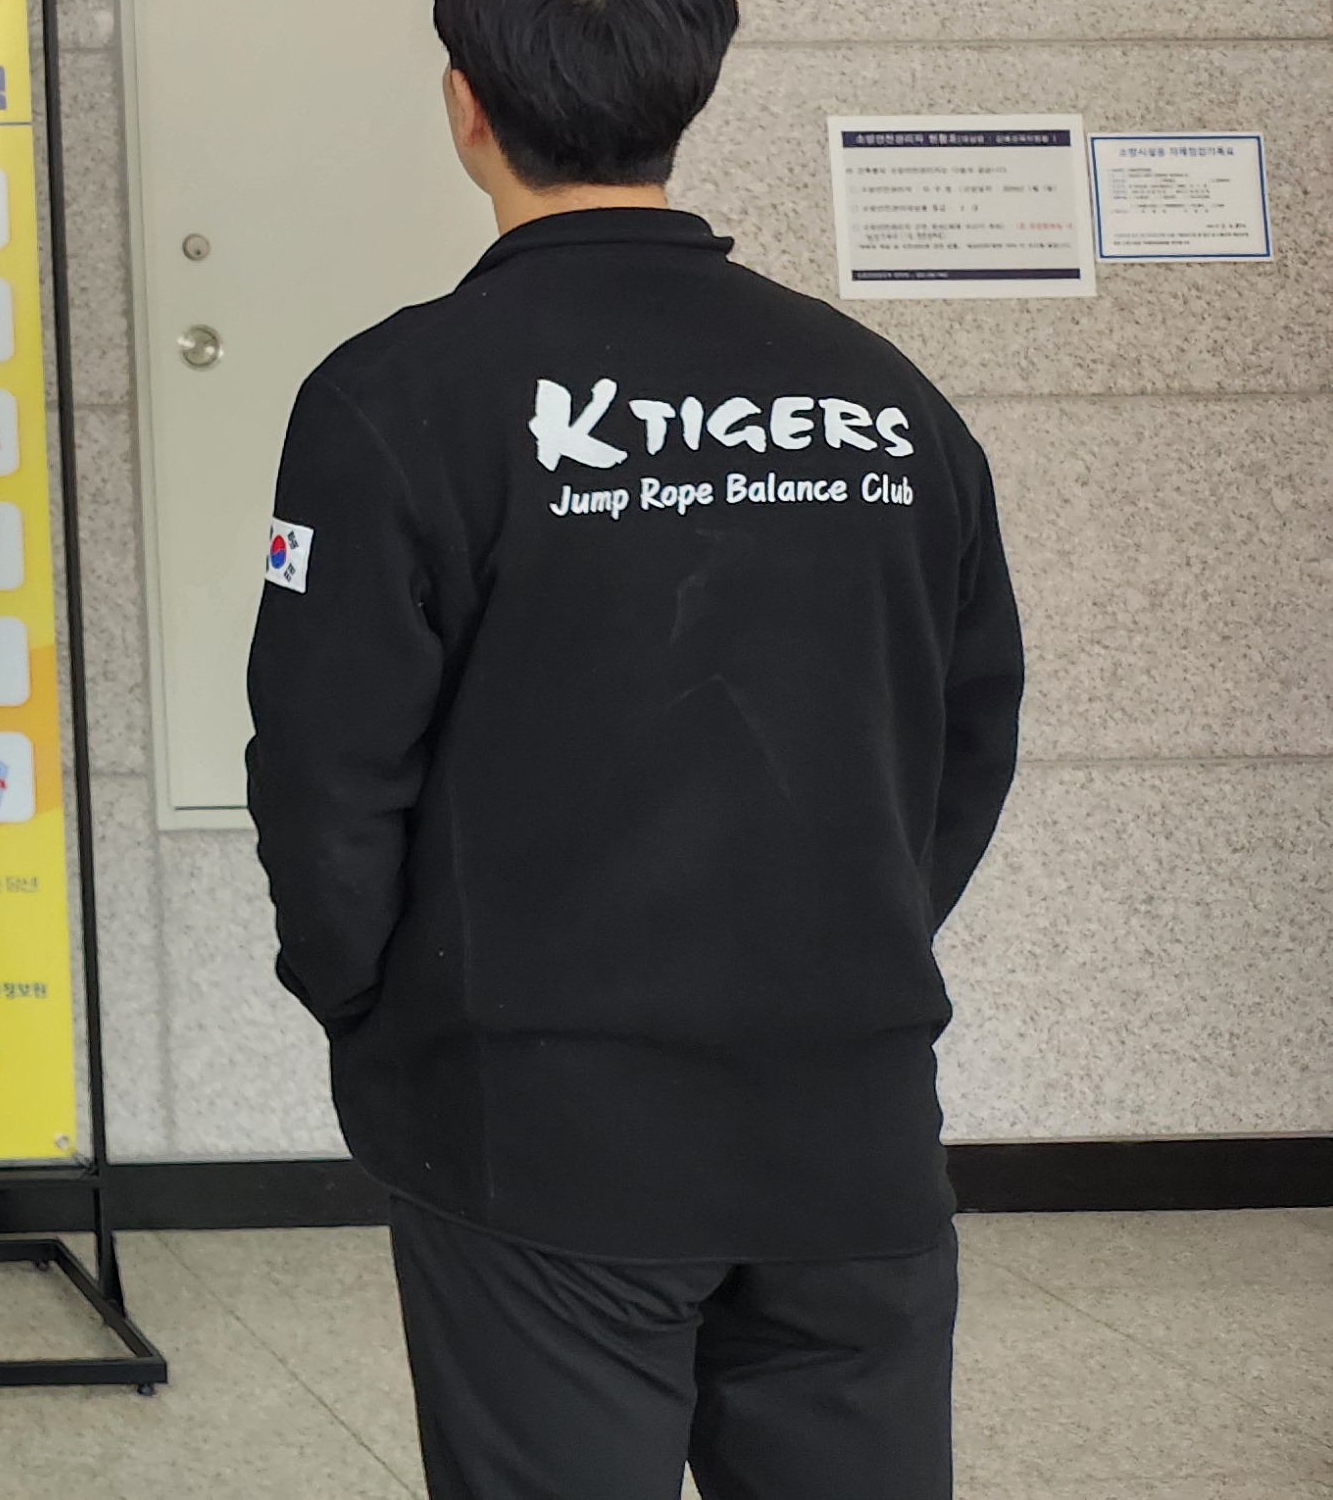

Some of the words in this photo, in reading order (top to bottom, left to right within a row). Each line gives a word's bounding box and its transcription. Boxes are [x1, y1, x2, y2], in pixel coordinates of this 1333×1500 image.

[549, 483, 629, 520] Jump
[640, 476, 714, 512] Rope
[726, 473, 849, 505] Balance
[861, 472, 915, 506] Club
